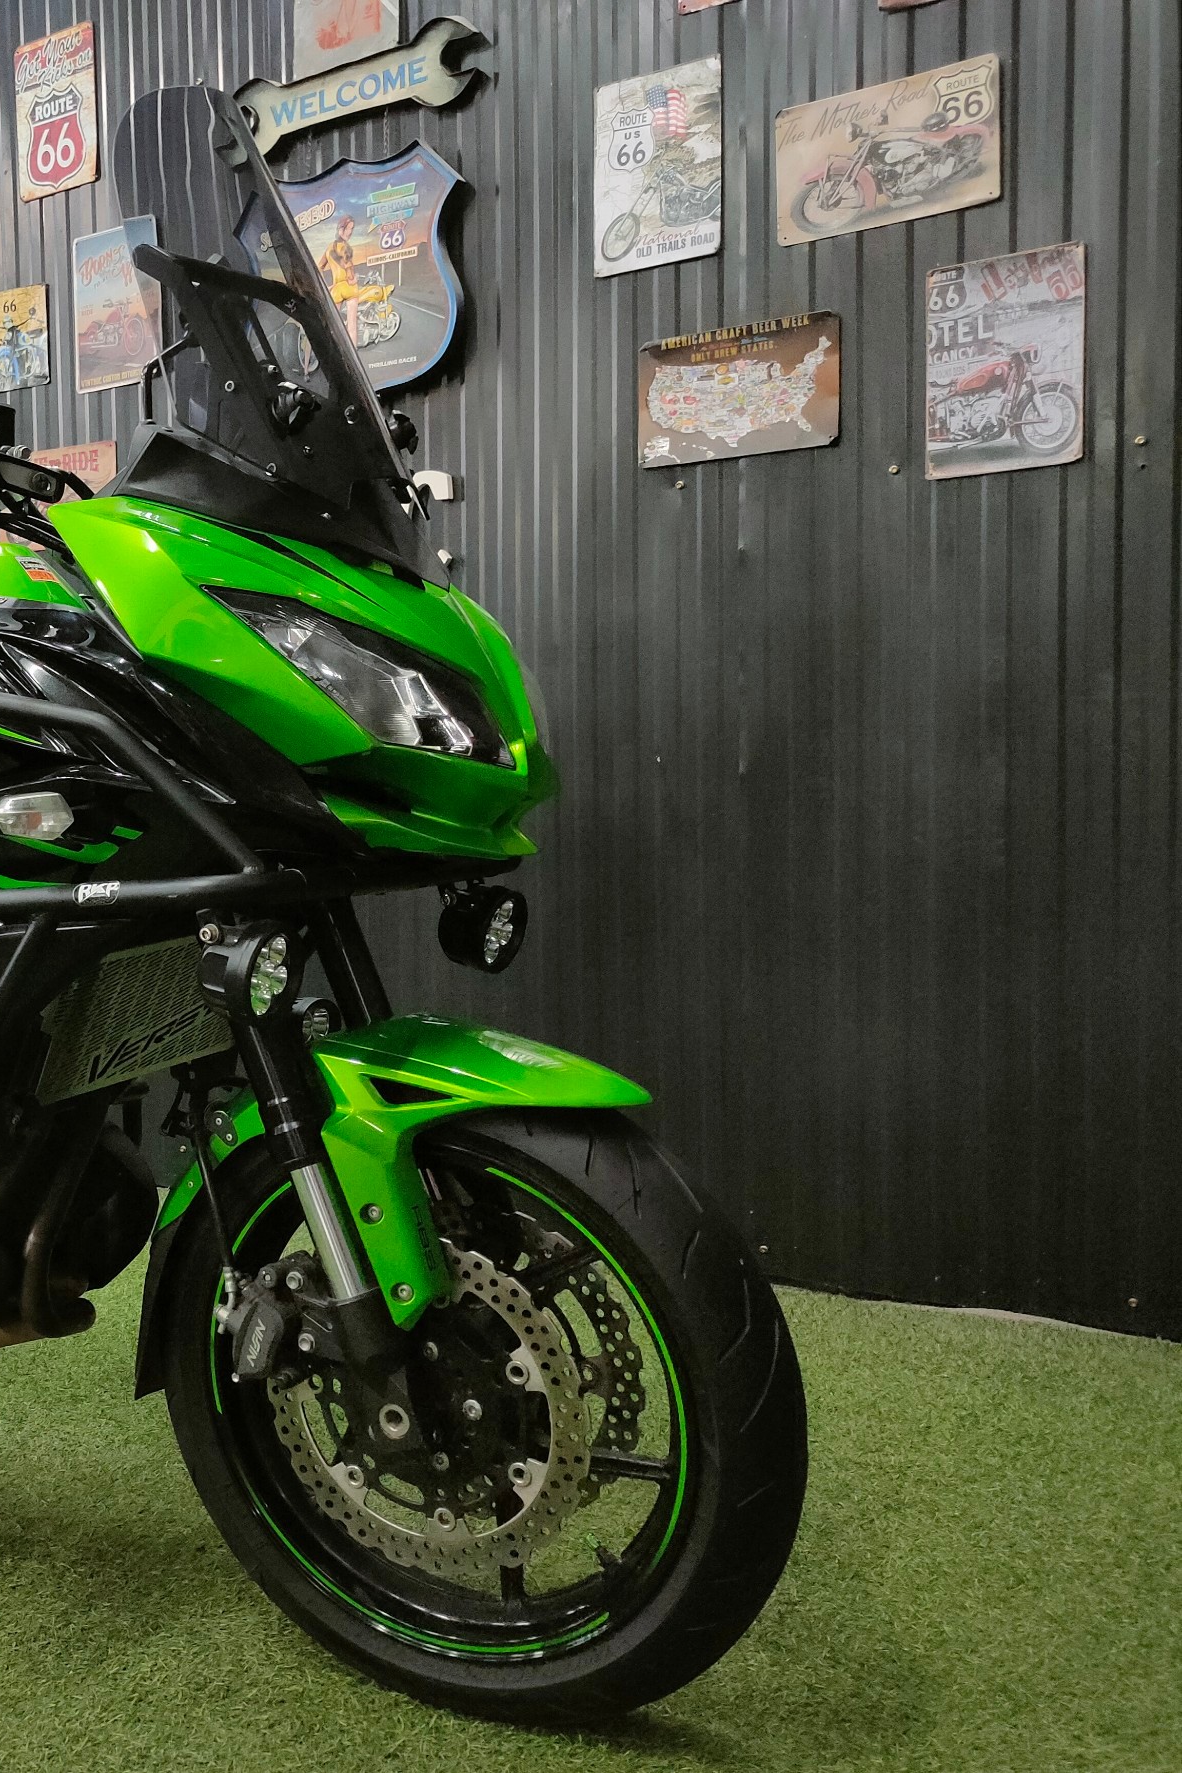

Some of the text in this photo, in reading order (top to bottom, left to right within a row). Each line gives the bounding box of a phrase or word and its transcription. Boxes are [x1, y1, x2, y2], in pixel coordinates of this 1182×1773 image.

[37, 48, 93, 92] Kicks on
[945, 73, 980, 92] ROUTE
[270, 56, 429, 128] WELCOME
[34, 95, 78, 121] ROUTE
[619, 112, 648, 128] ROUTE
[778, 74, 934, 152] The Mother Road
[942, 90, 985, 124] 66
[36, 122, 76, 174] 66
[624, 130, 641, 140] US
[616, 141, 646, 167] 66
[369, 197, 417, 215] HIGHWAY
[381, 229, 403, 249] 66
[634, 221, 700, 248] National
[636, 232, 715, 259] OLD TRAILS ROAD
[2, 298, 17, 314] 66
[929, 285, 960, 311] 66
[661, 331, 713, 350] AMERICAN
[715, 325, 748, 341] CRAFT
[752, 319, 778, 335] BEER
[781, 314, 811, 329] WEEK
[62, 449, 100, 472] RIDE
